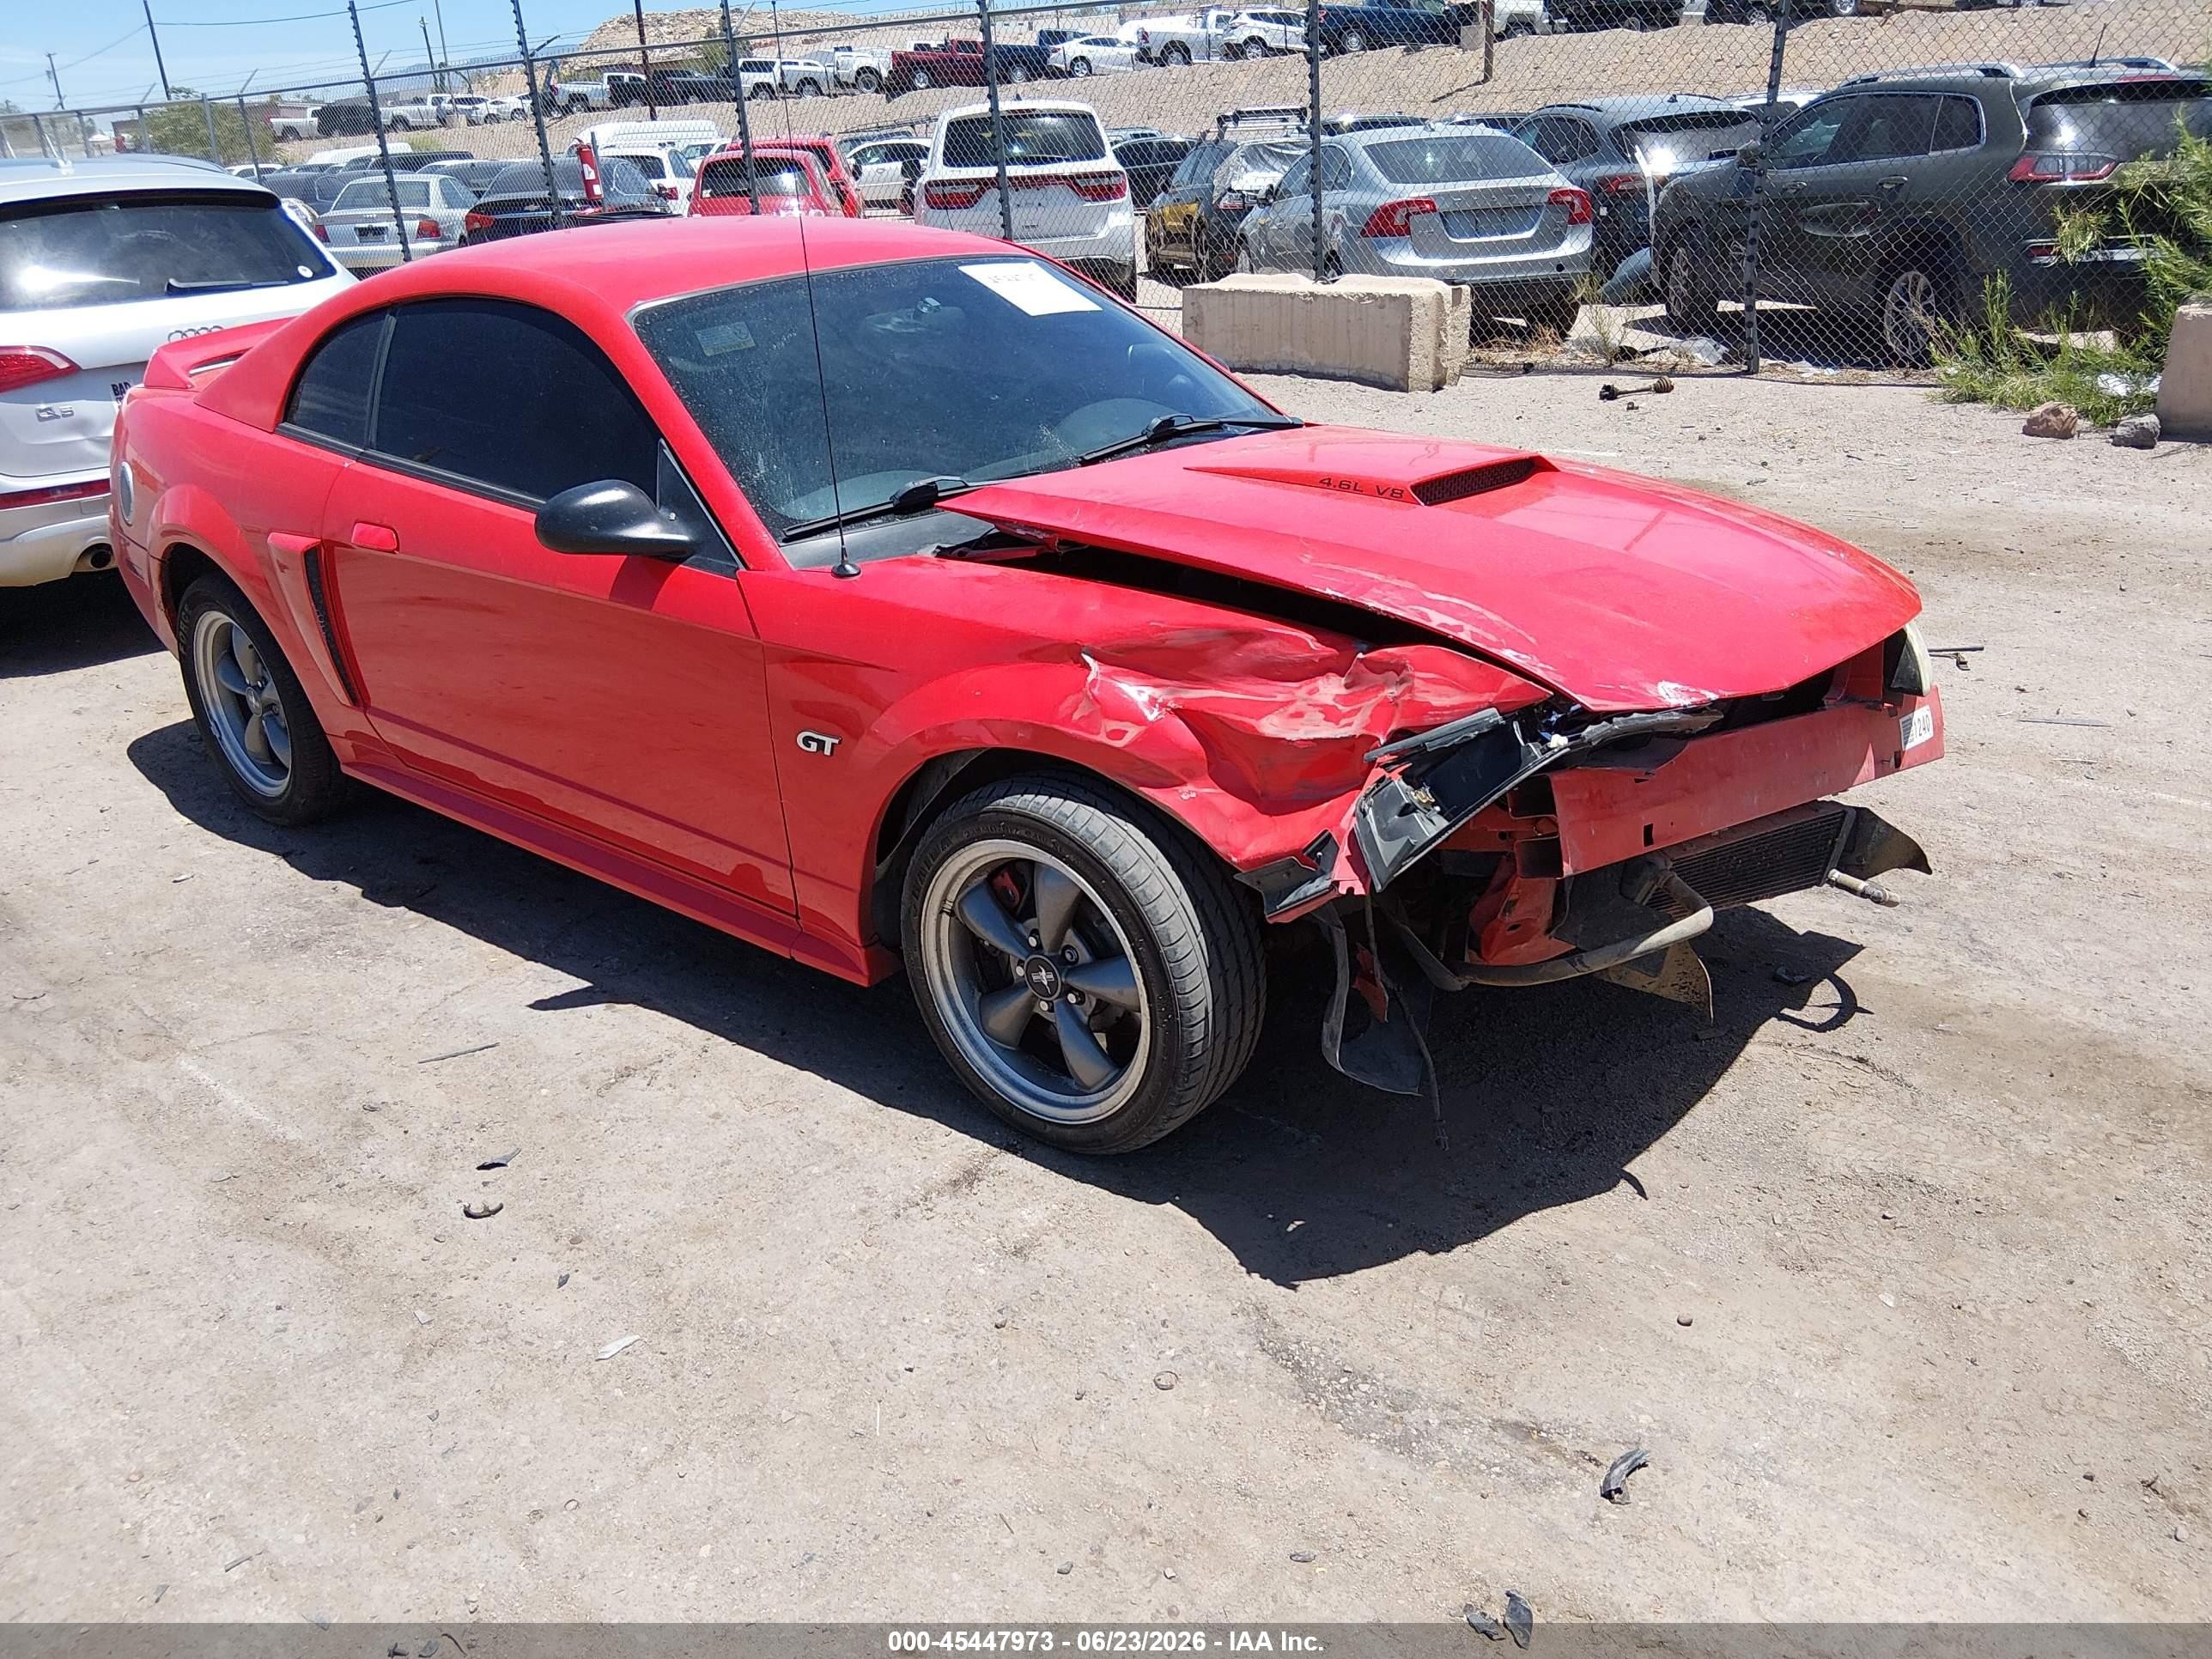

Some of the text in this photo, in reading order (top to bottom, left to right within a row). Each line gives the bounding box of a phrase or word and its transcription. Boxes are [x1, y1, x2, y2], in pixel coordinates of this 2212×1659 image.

[35, 404, 75, 422] Q5
[1319, 477, 1405, 499] 4.6L V8
[796, 730, 842, 757] GT
